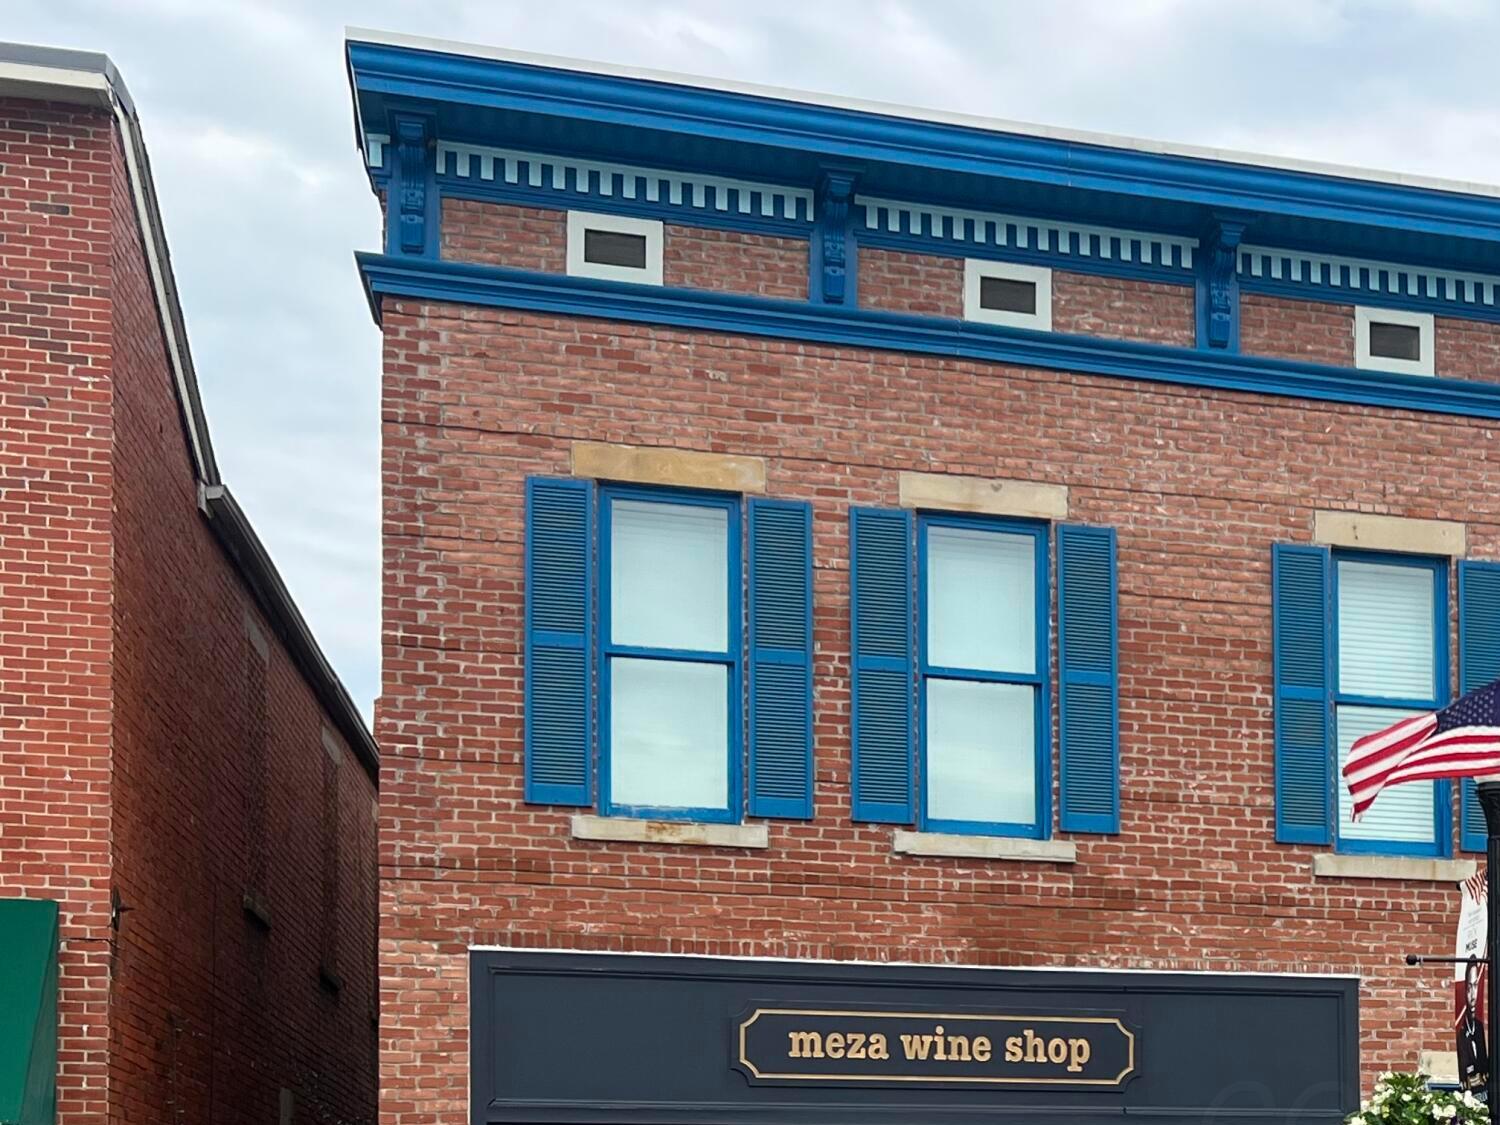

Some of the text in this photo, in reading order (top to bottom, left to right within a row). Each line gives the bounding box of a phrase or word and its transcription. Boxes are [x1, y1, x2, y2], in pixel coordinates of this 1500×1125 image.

[788, 1025, 1091, 1072] meza wine shop
